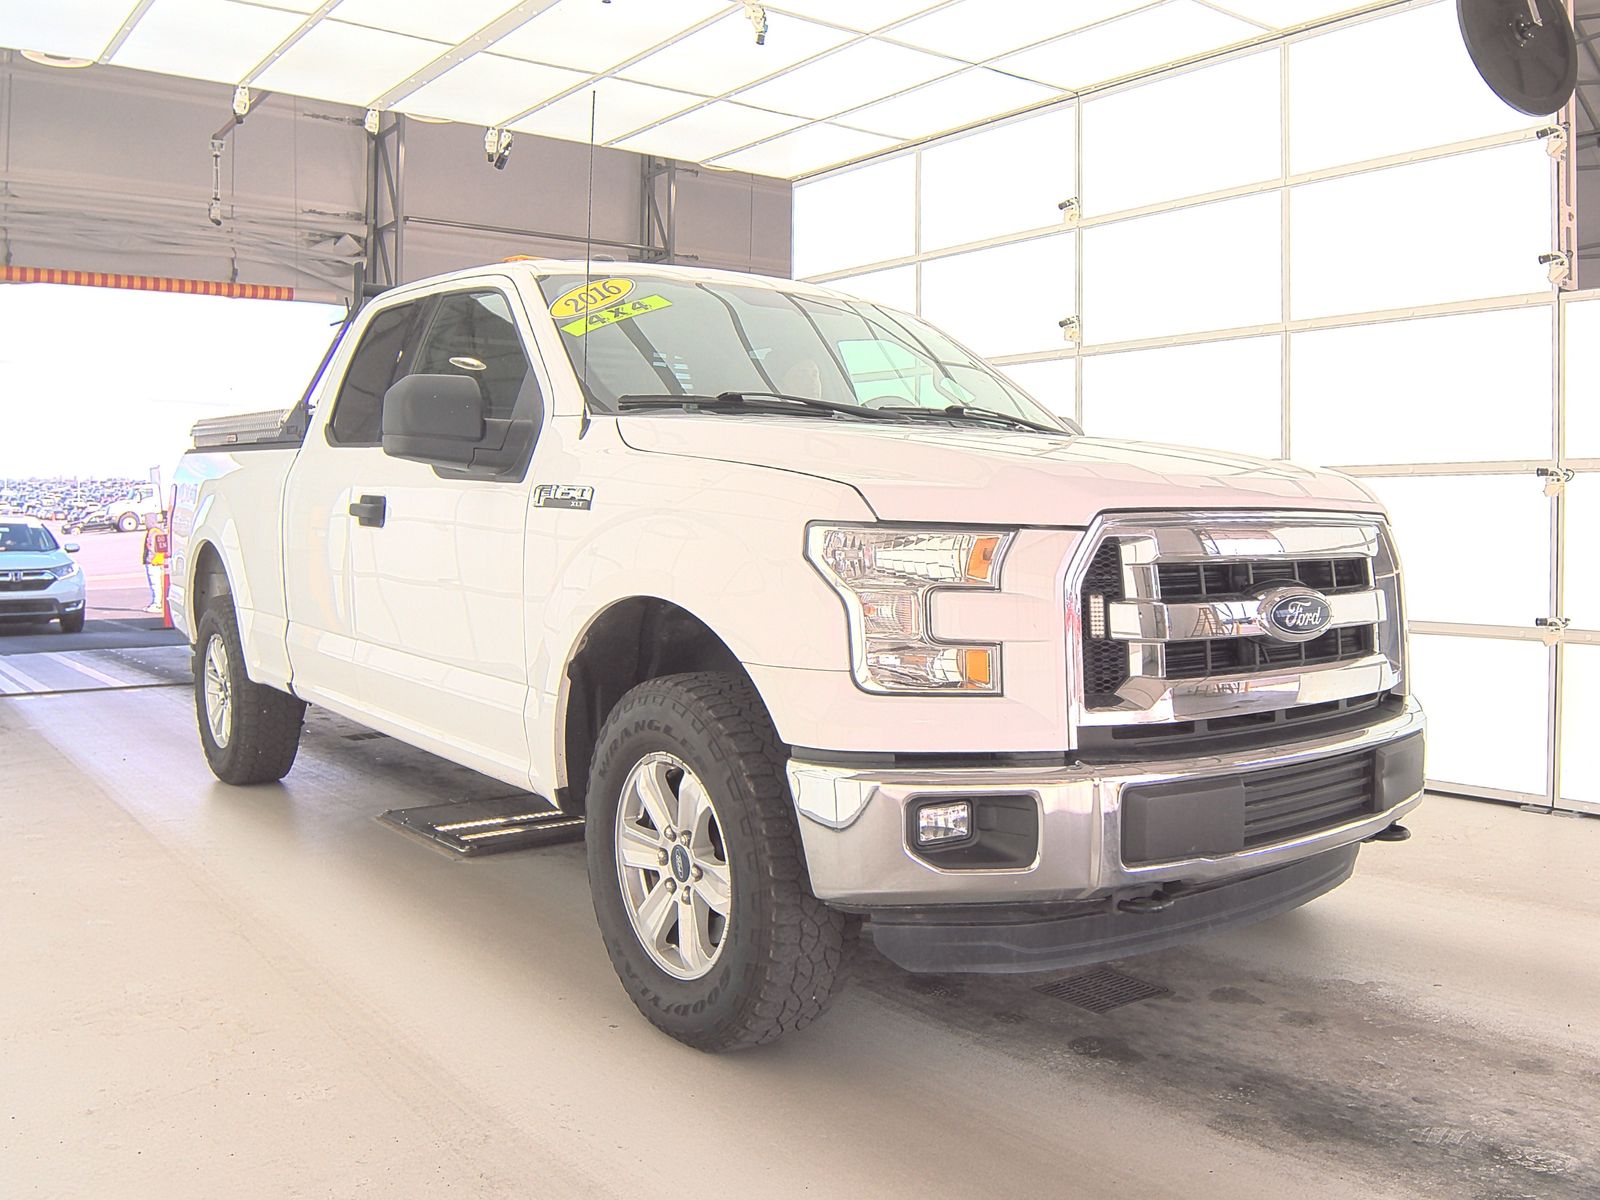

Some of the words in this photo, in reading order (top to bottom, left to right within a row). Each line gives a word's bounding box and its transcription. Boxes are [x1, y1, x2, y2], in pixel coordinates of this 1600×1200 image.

[564, 281, 622, 313] 2016
[1284, 601, 1322, 628] Ford
[598, 718, 708, 779] WRANGLER
